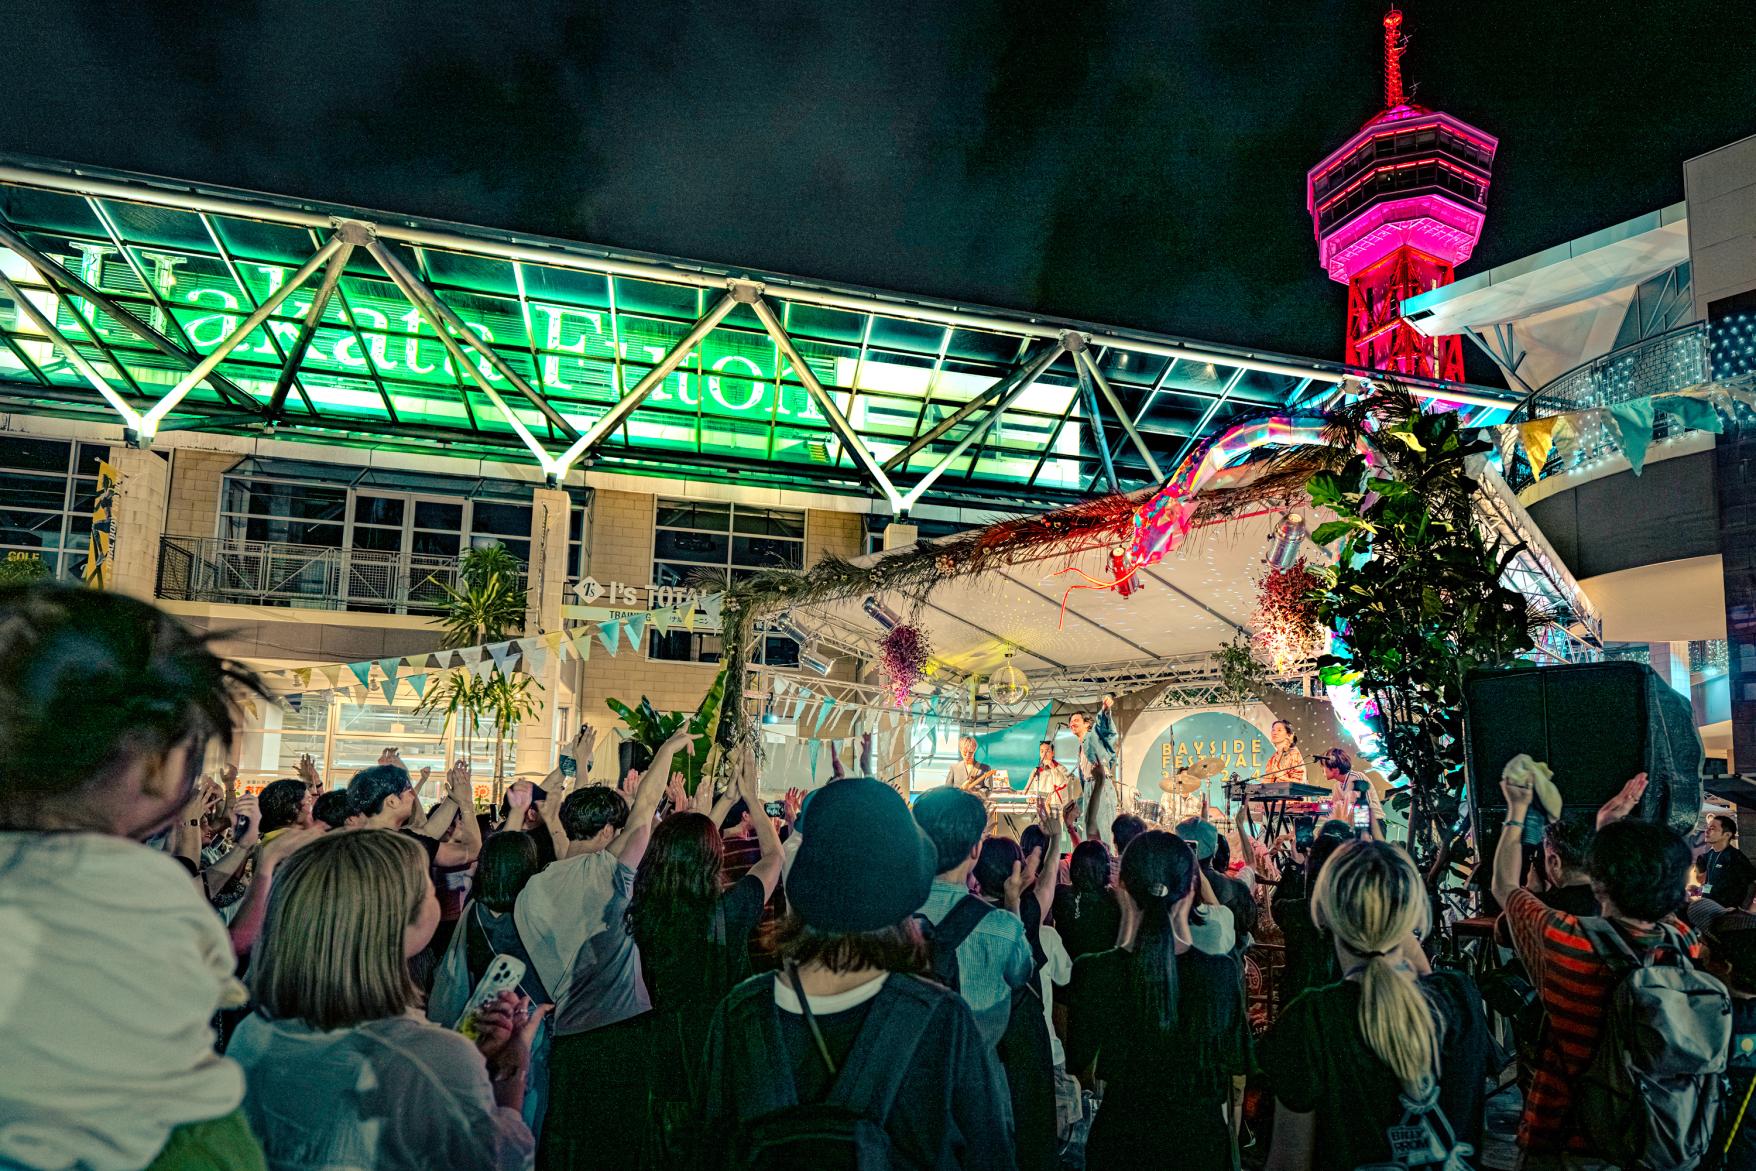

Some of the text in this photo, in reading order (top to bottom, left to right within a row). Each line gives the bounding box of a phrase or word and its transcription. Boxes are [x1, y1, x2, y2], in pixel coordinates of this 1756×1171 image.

[609, 581, 707, 609] I's TOTA
[1161, 739, 1261, 756] BAYSIDE
[1161, 753, 1262, 769] FESVAL
[1161, 769, 1260, 782] 224
